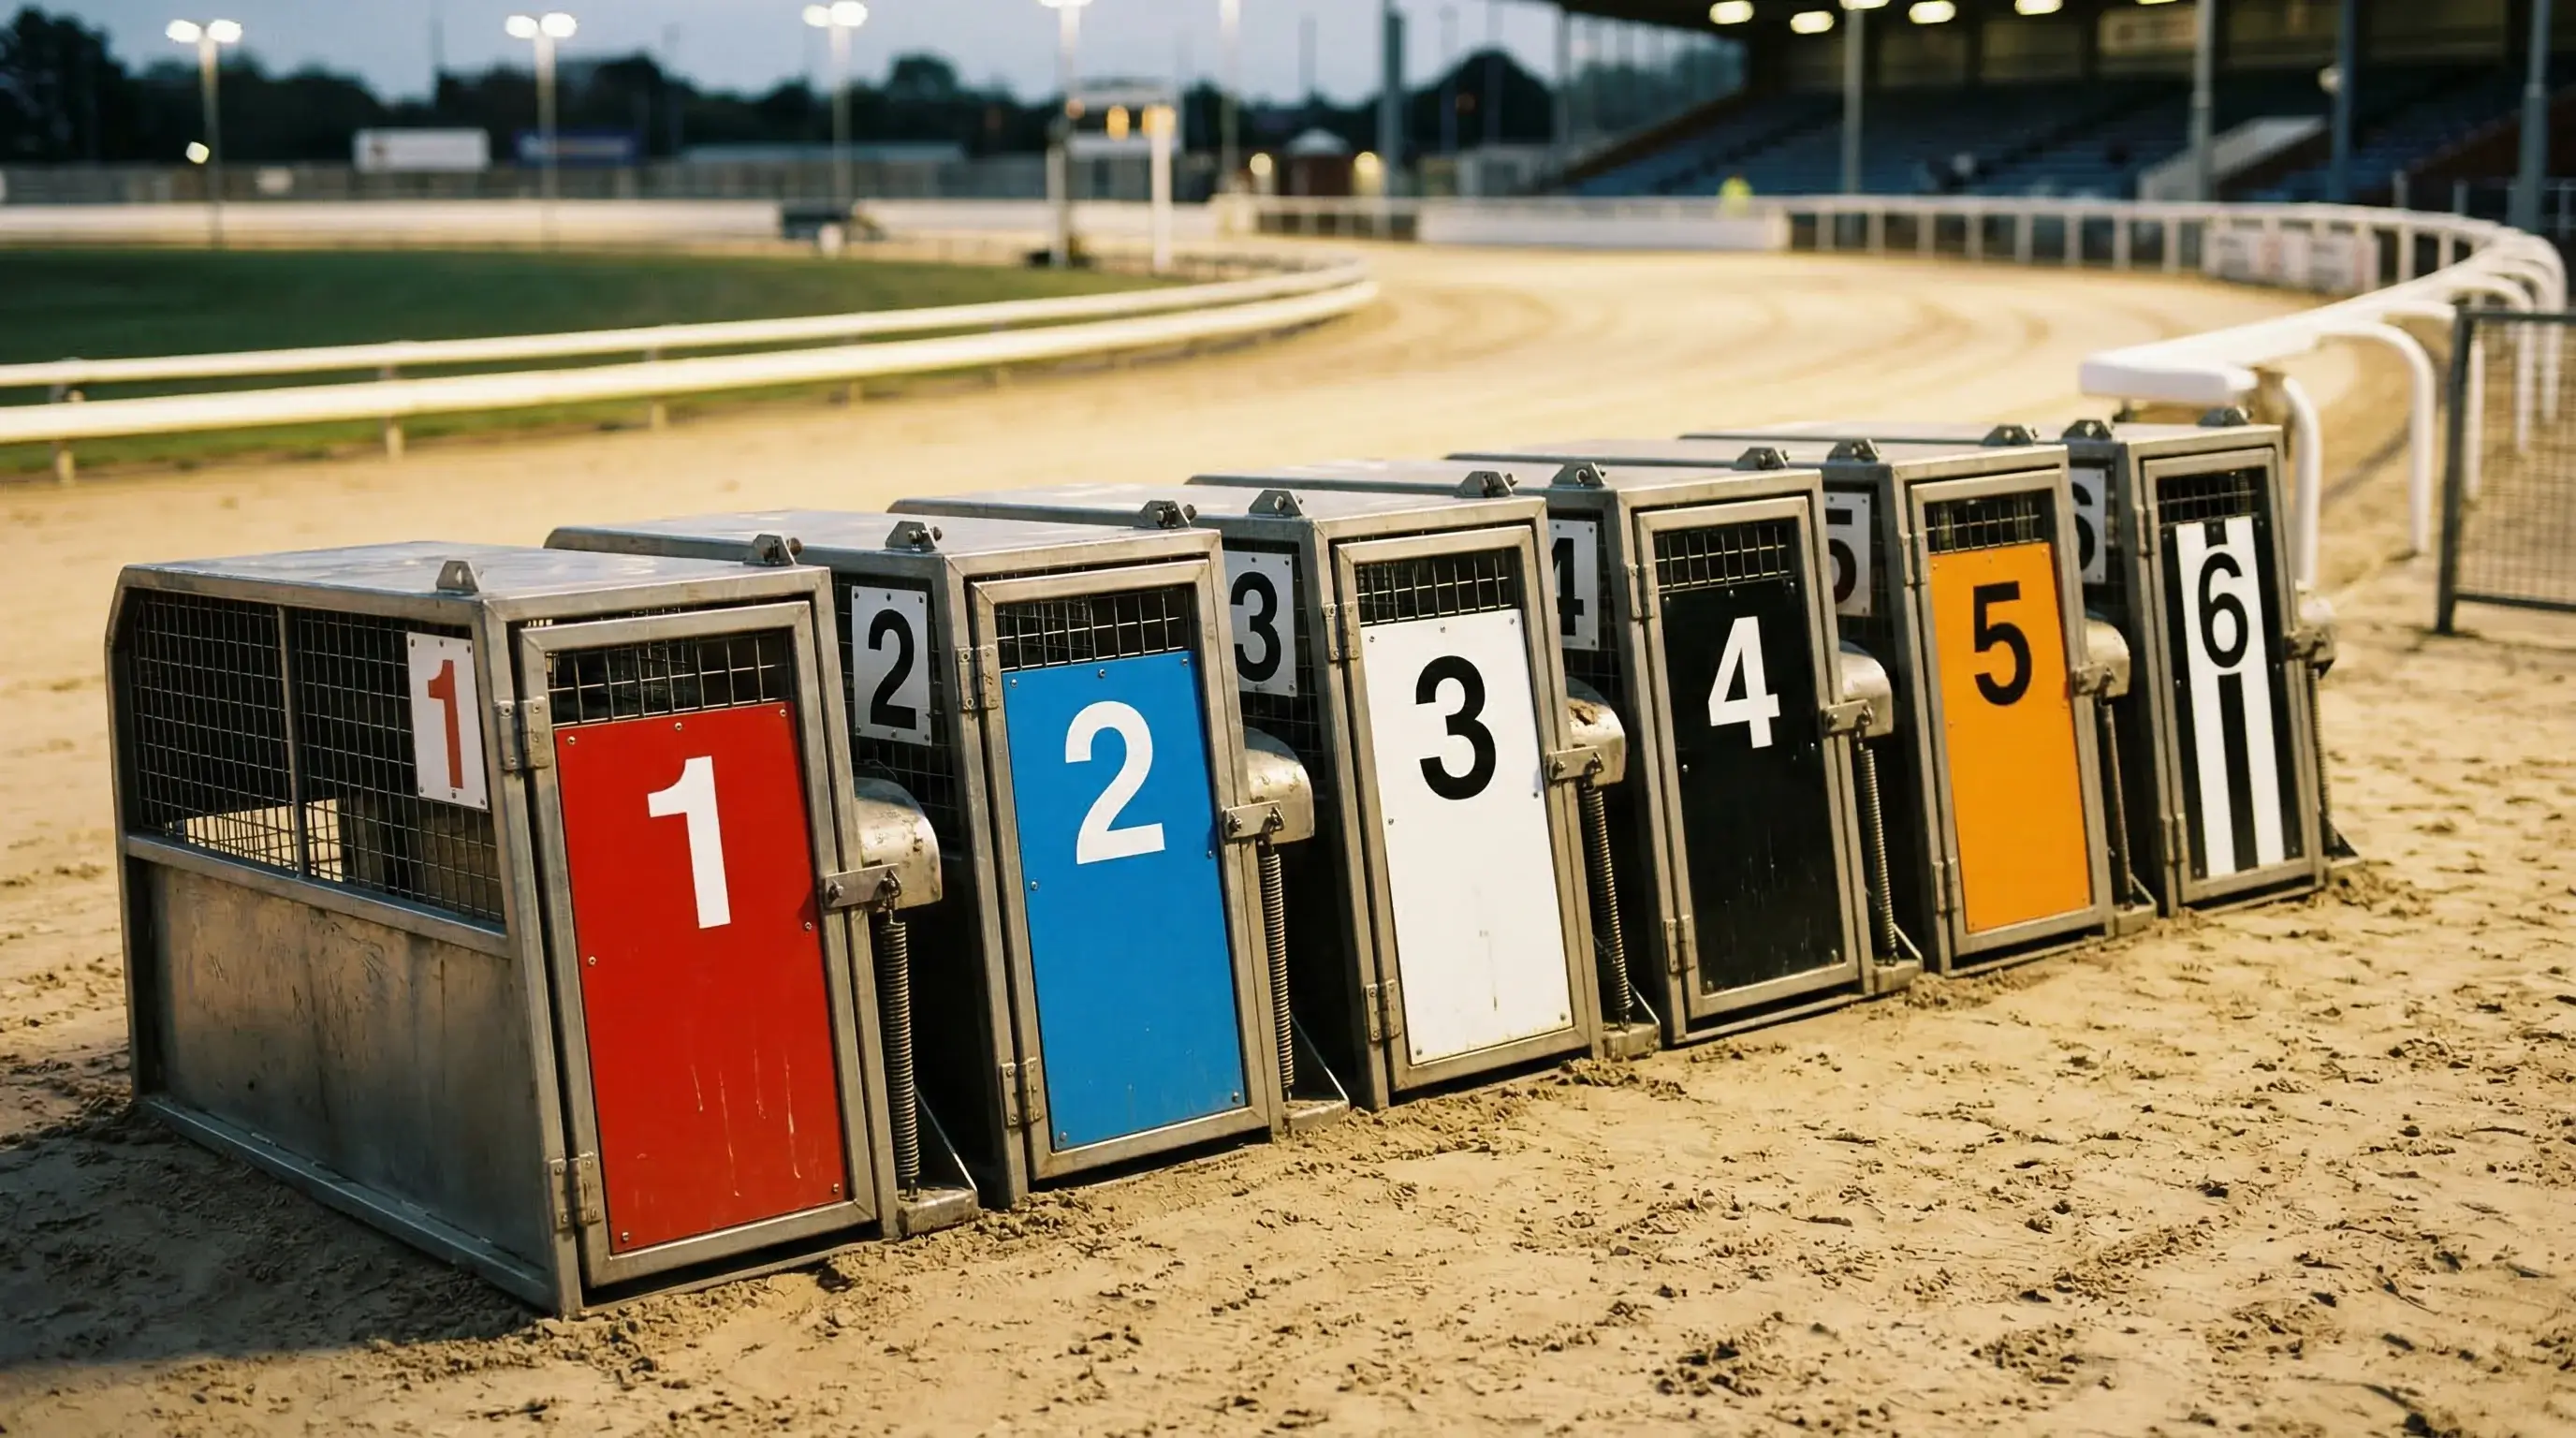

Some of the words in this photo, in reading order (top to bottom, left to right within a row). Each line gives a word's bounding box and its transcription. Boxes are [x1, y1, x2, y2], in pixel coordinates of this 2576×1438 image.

[868, 609, 916, 729] 2
[1230, 571, 1281, 682] 3
[1973, 580, 2032, 706] 5
[2198, 552, 2248, 669] 6
[428, 659, 463, 789] 1
[1415, 655, 1497, 800] 3
[1708, 616, 1780, 749] 4
[648, 756, 731, 929] 1
[1065, 701, 1165, 864] 2
